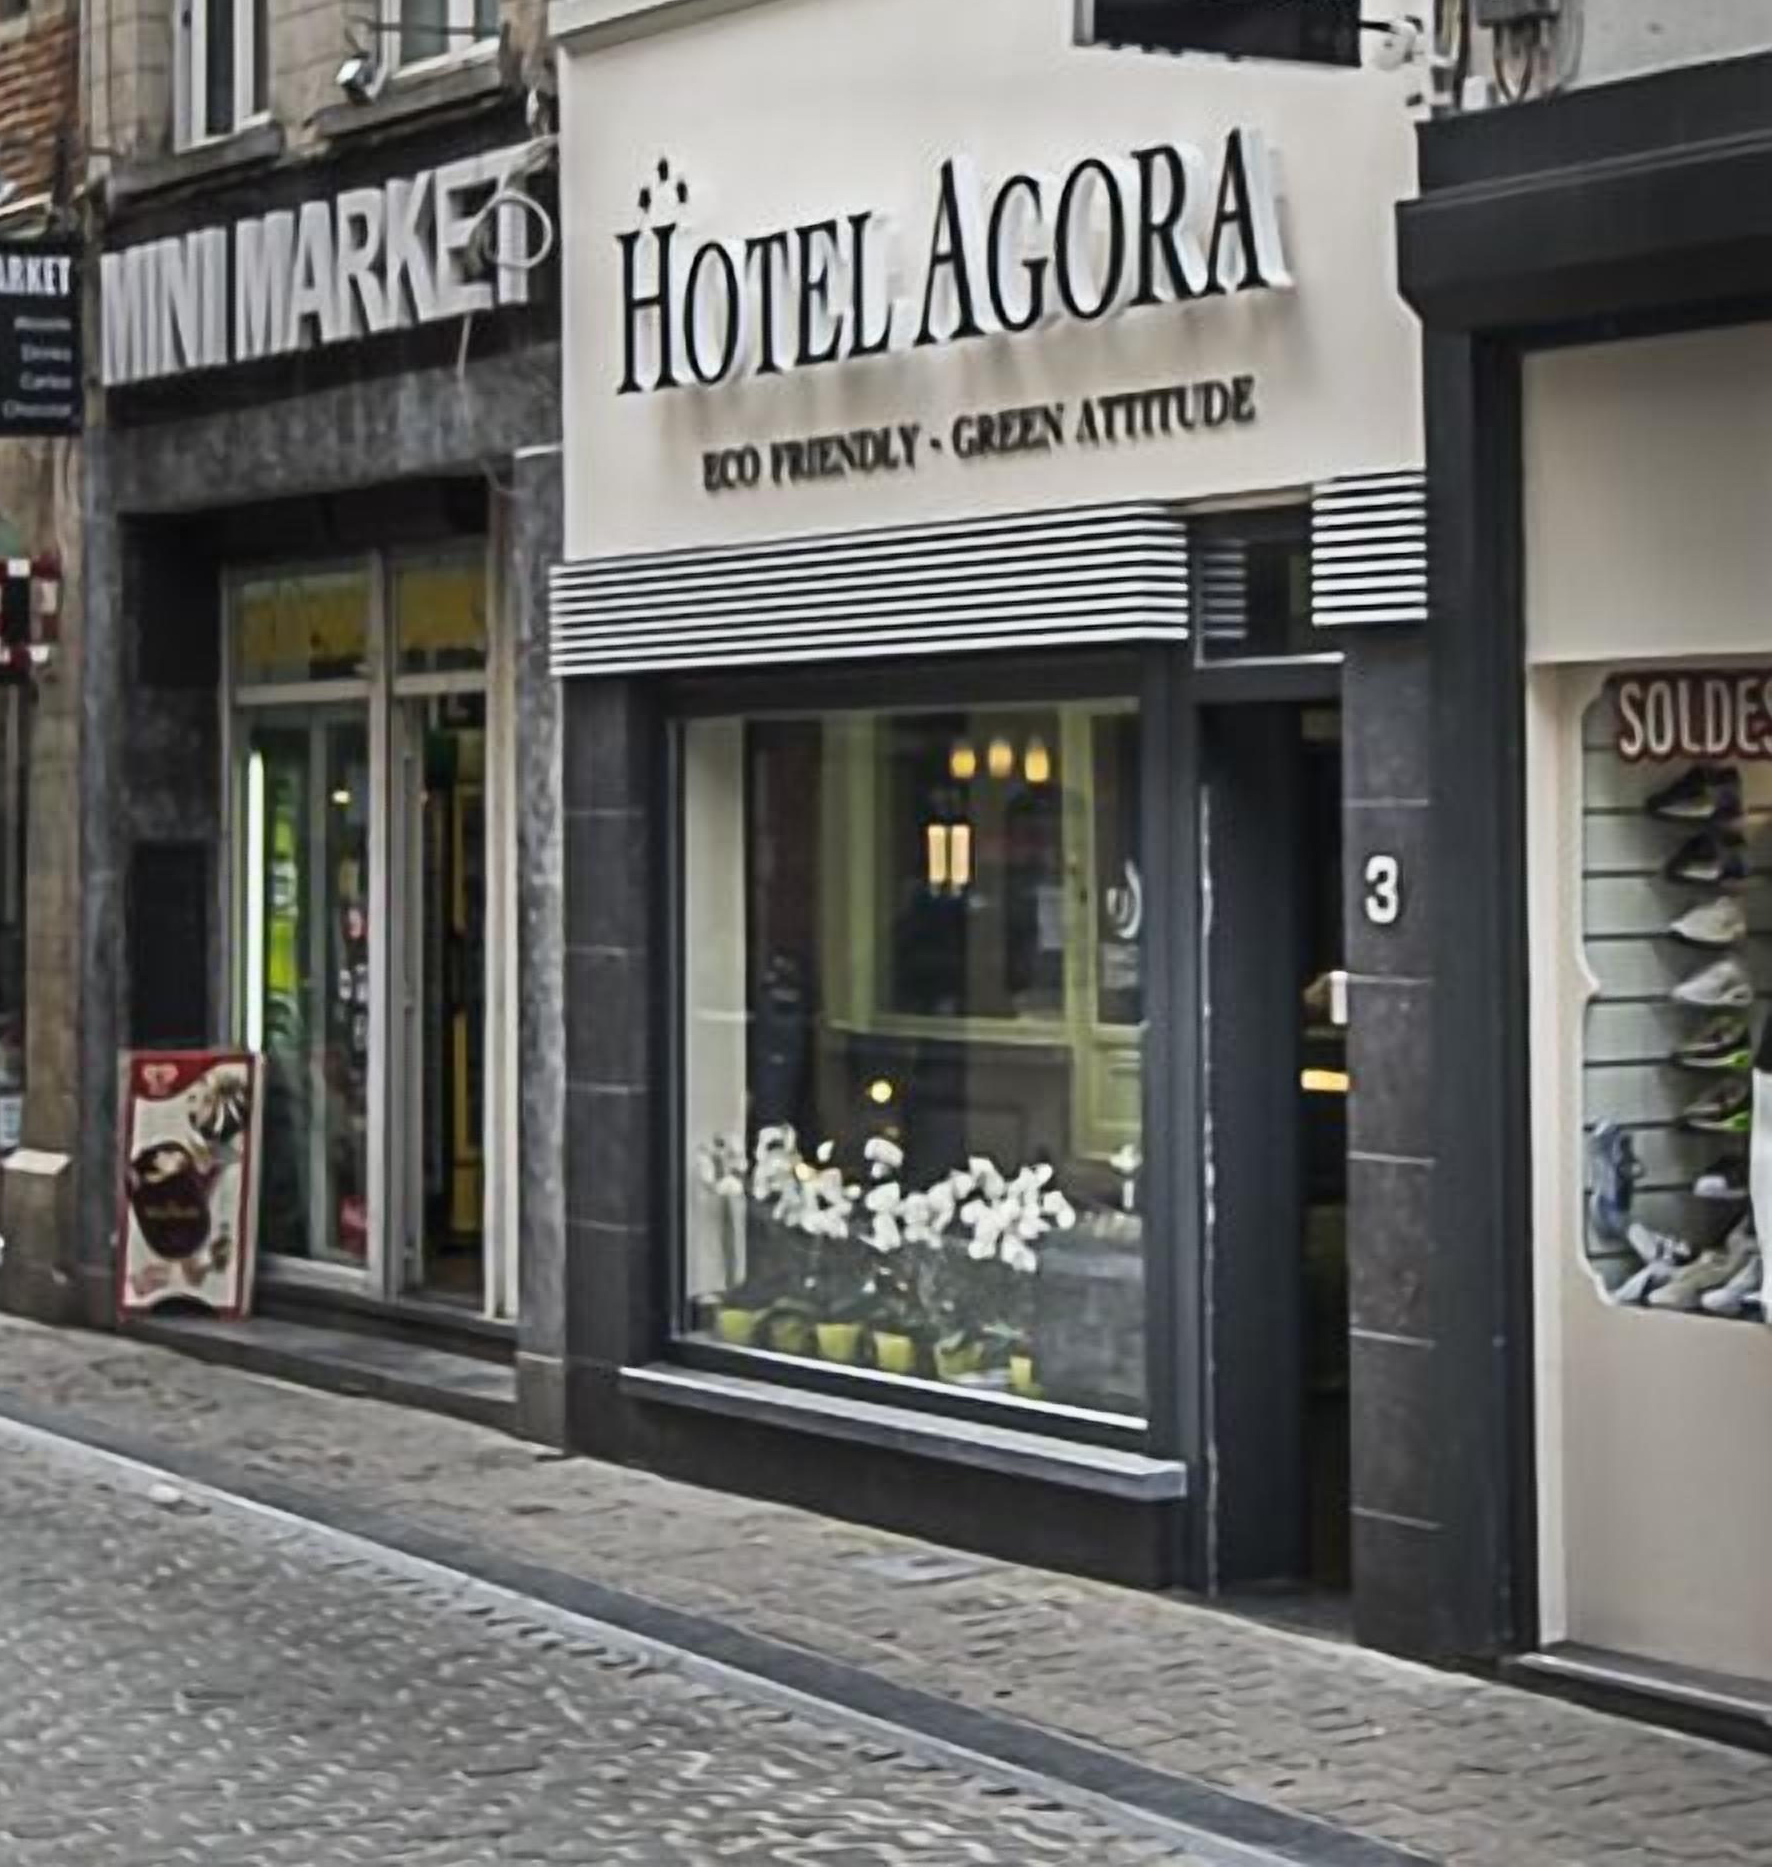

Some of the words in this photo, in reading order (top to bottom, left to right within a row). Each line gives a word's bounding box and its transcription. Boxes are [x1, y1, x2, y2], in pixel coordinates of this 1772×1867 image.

[100, 226, 228, 388] MINI
[235, 143, 542, 363] MARKET
[616, 211, 892, 396] HOTEL
[913, 127, 1271, 347] AGORA
[703, 450, 761, 492] ECO
[769, 423, 921, 487] FRIENDLY
[951, 402, 1065, 459] GREEN
[1075, 374, 1257, 445] ATTITUDE
[1364, 855, 1400, 924] 3
